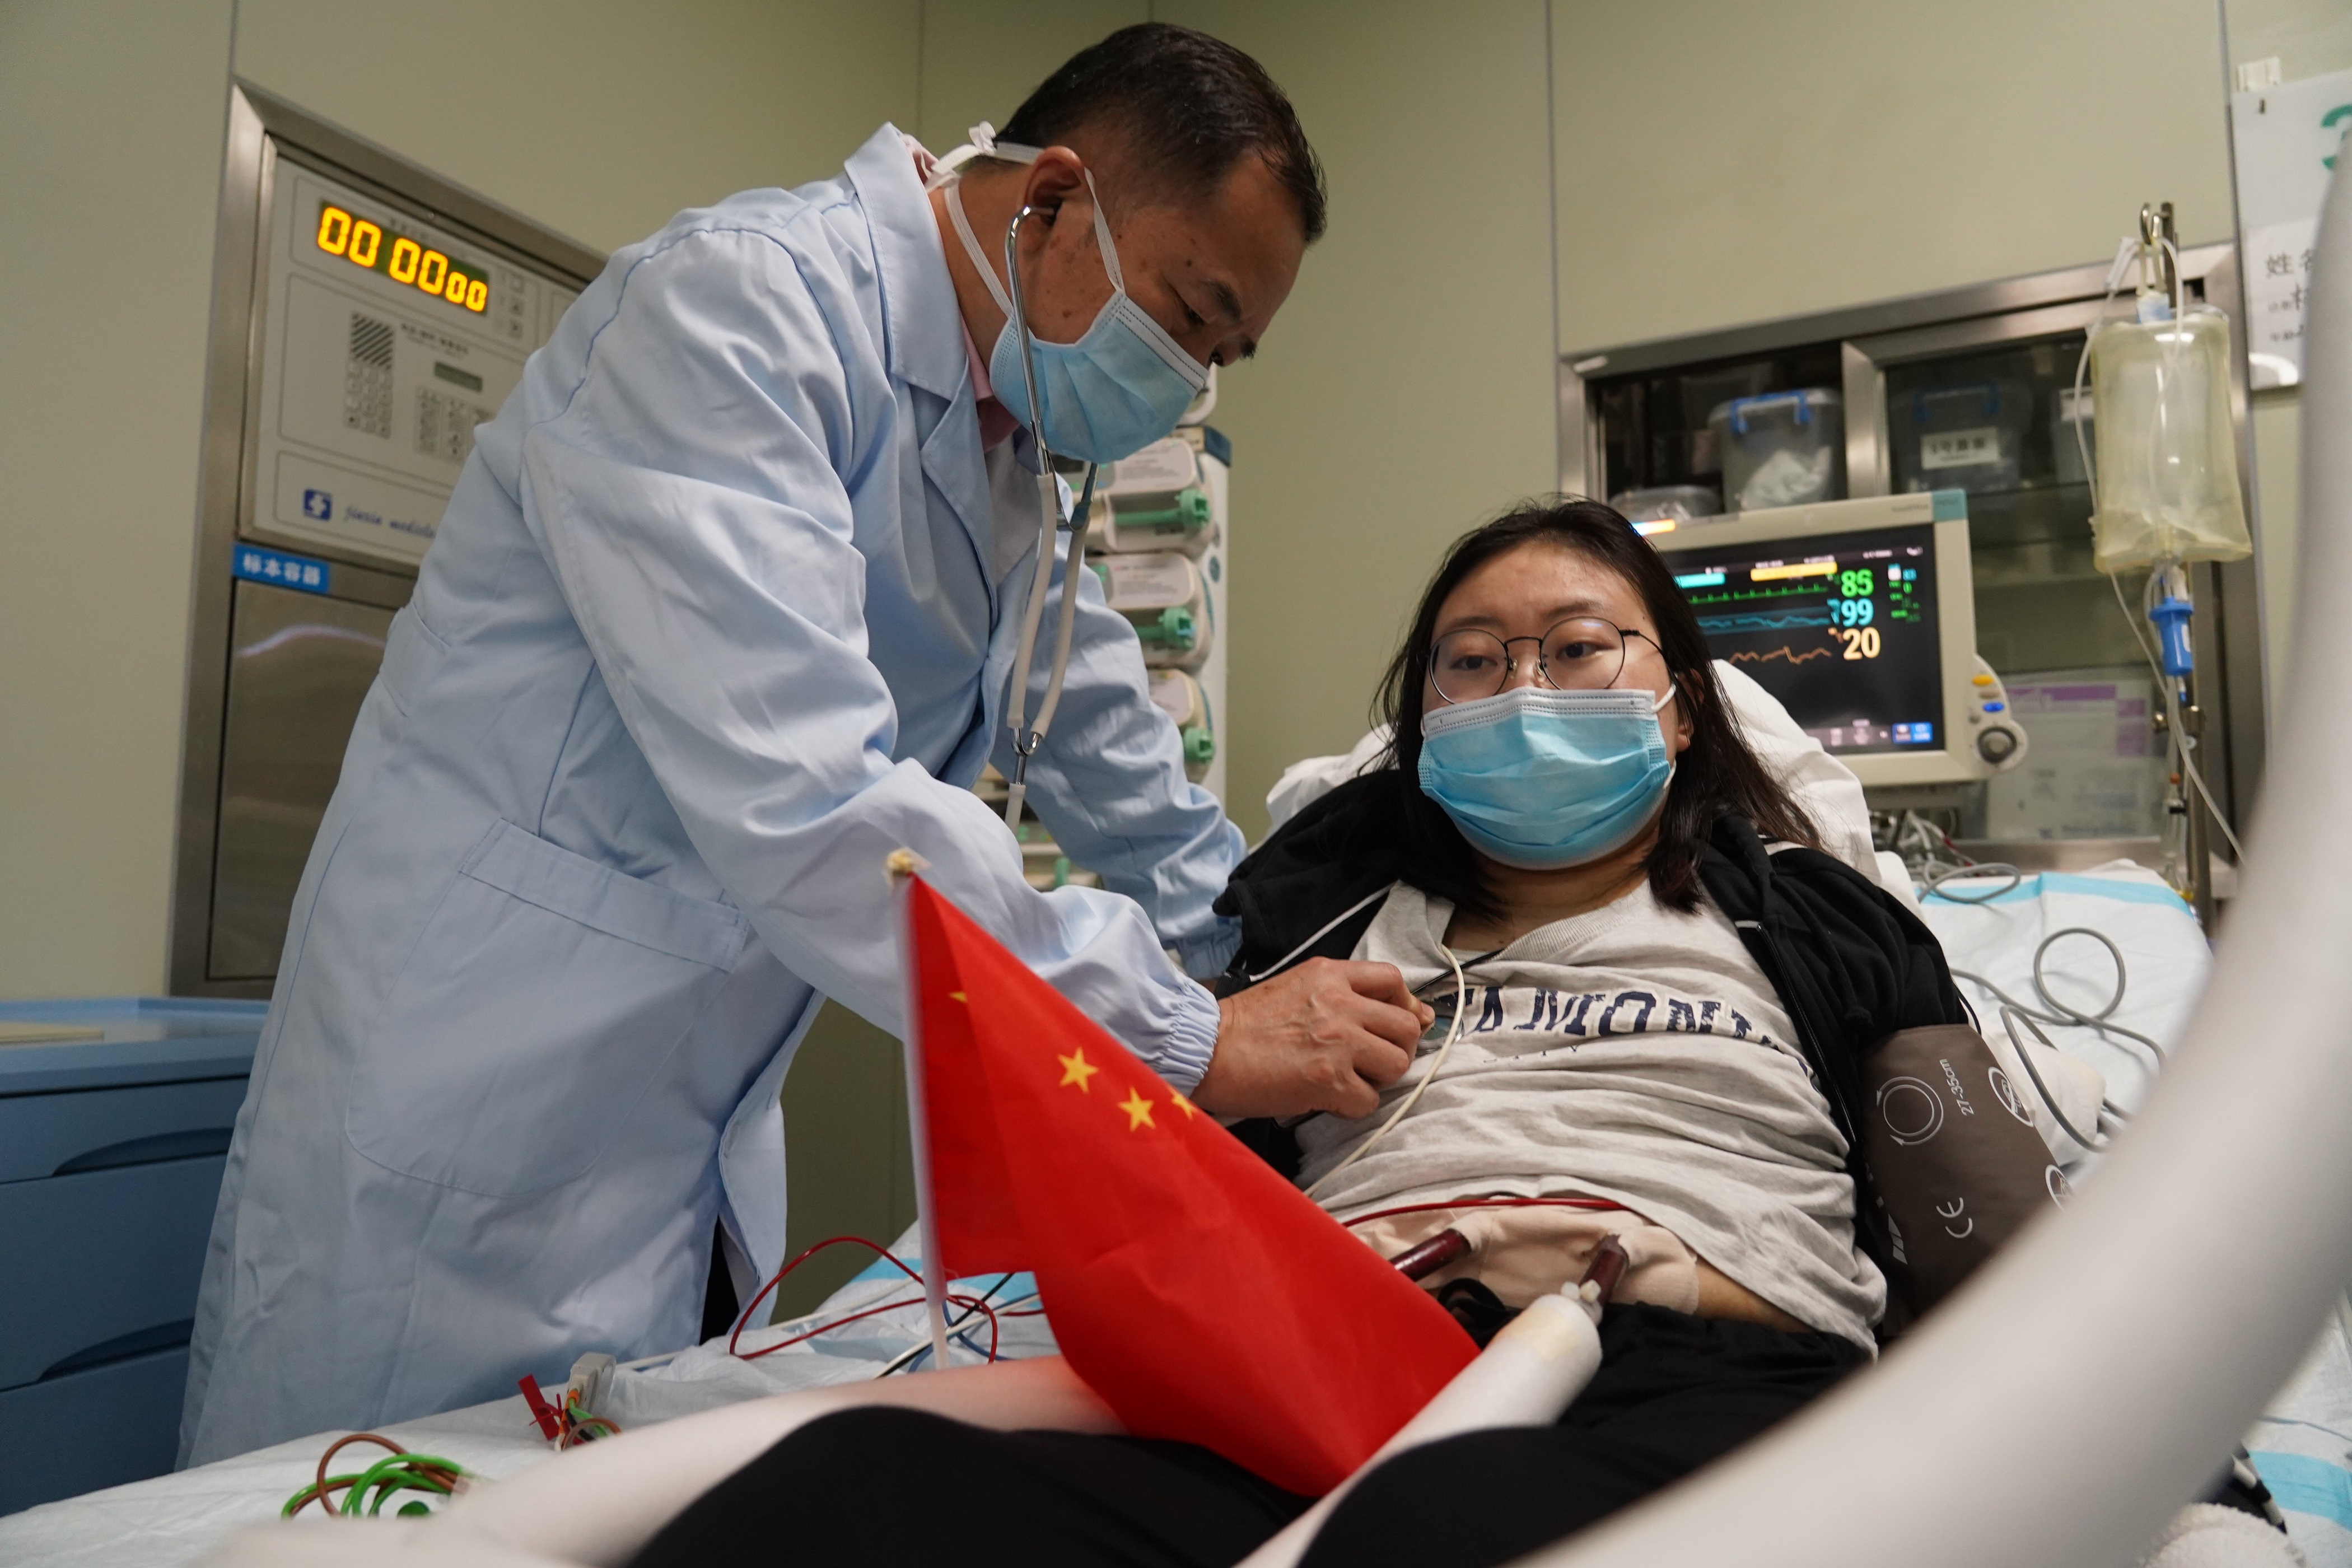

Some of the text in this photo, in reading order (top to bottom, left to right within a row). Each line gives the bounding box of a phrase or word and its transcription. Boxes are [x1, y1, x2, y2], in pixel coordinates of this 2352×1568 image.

[318, 206, 381, 268] 00
[1841, 568, 1874, 598] 85
[1841, 598, 1874, 627] 99
[1842, 627, 1880, 660] 20
[1939, 1058, 1975, 1116] 27-35cm
